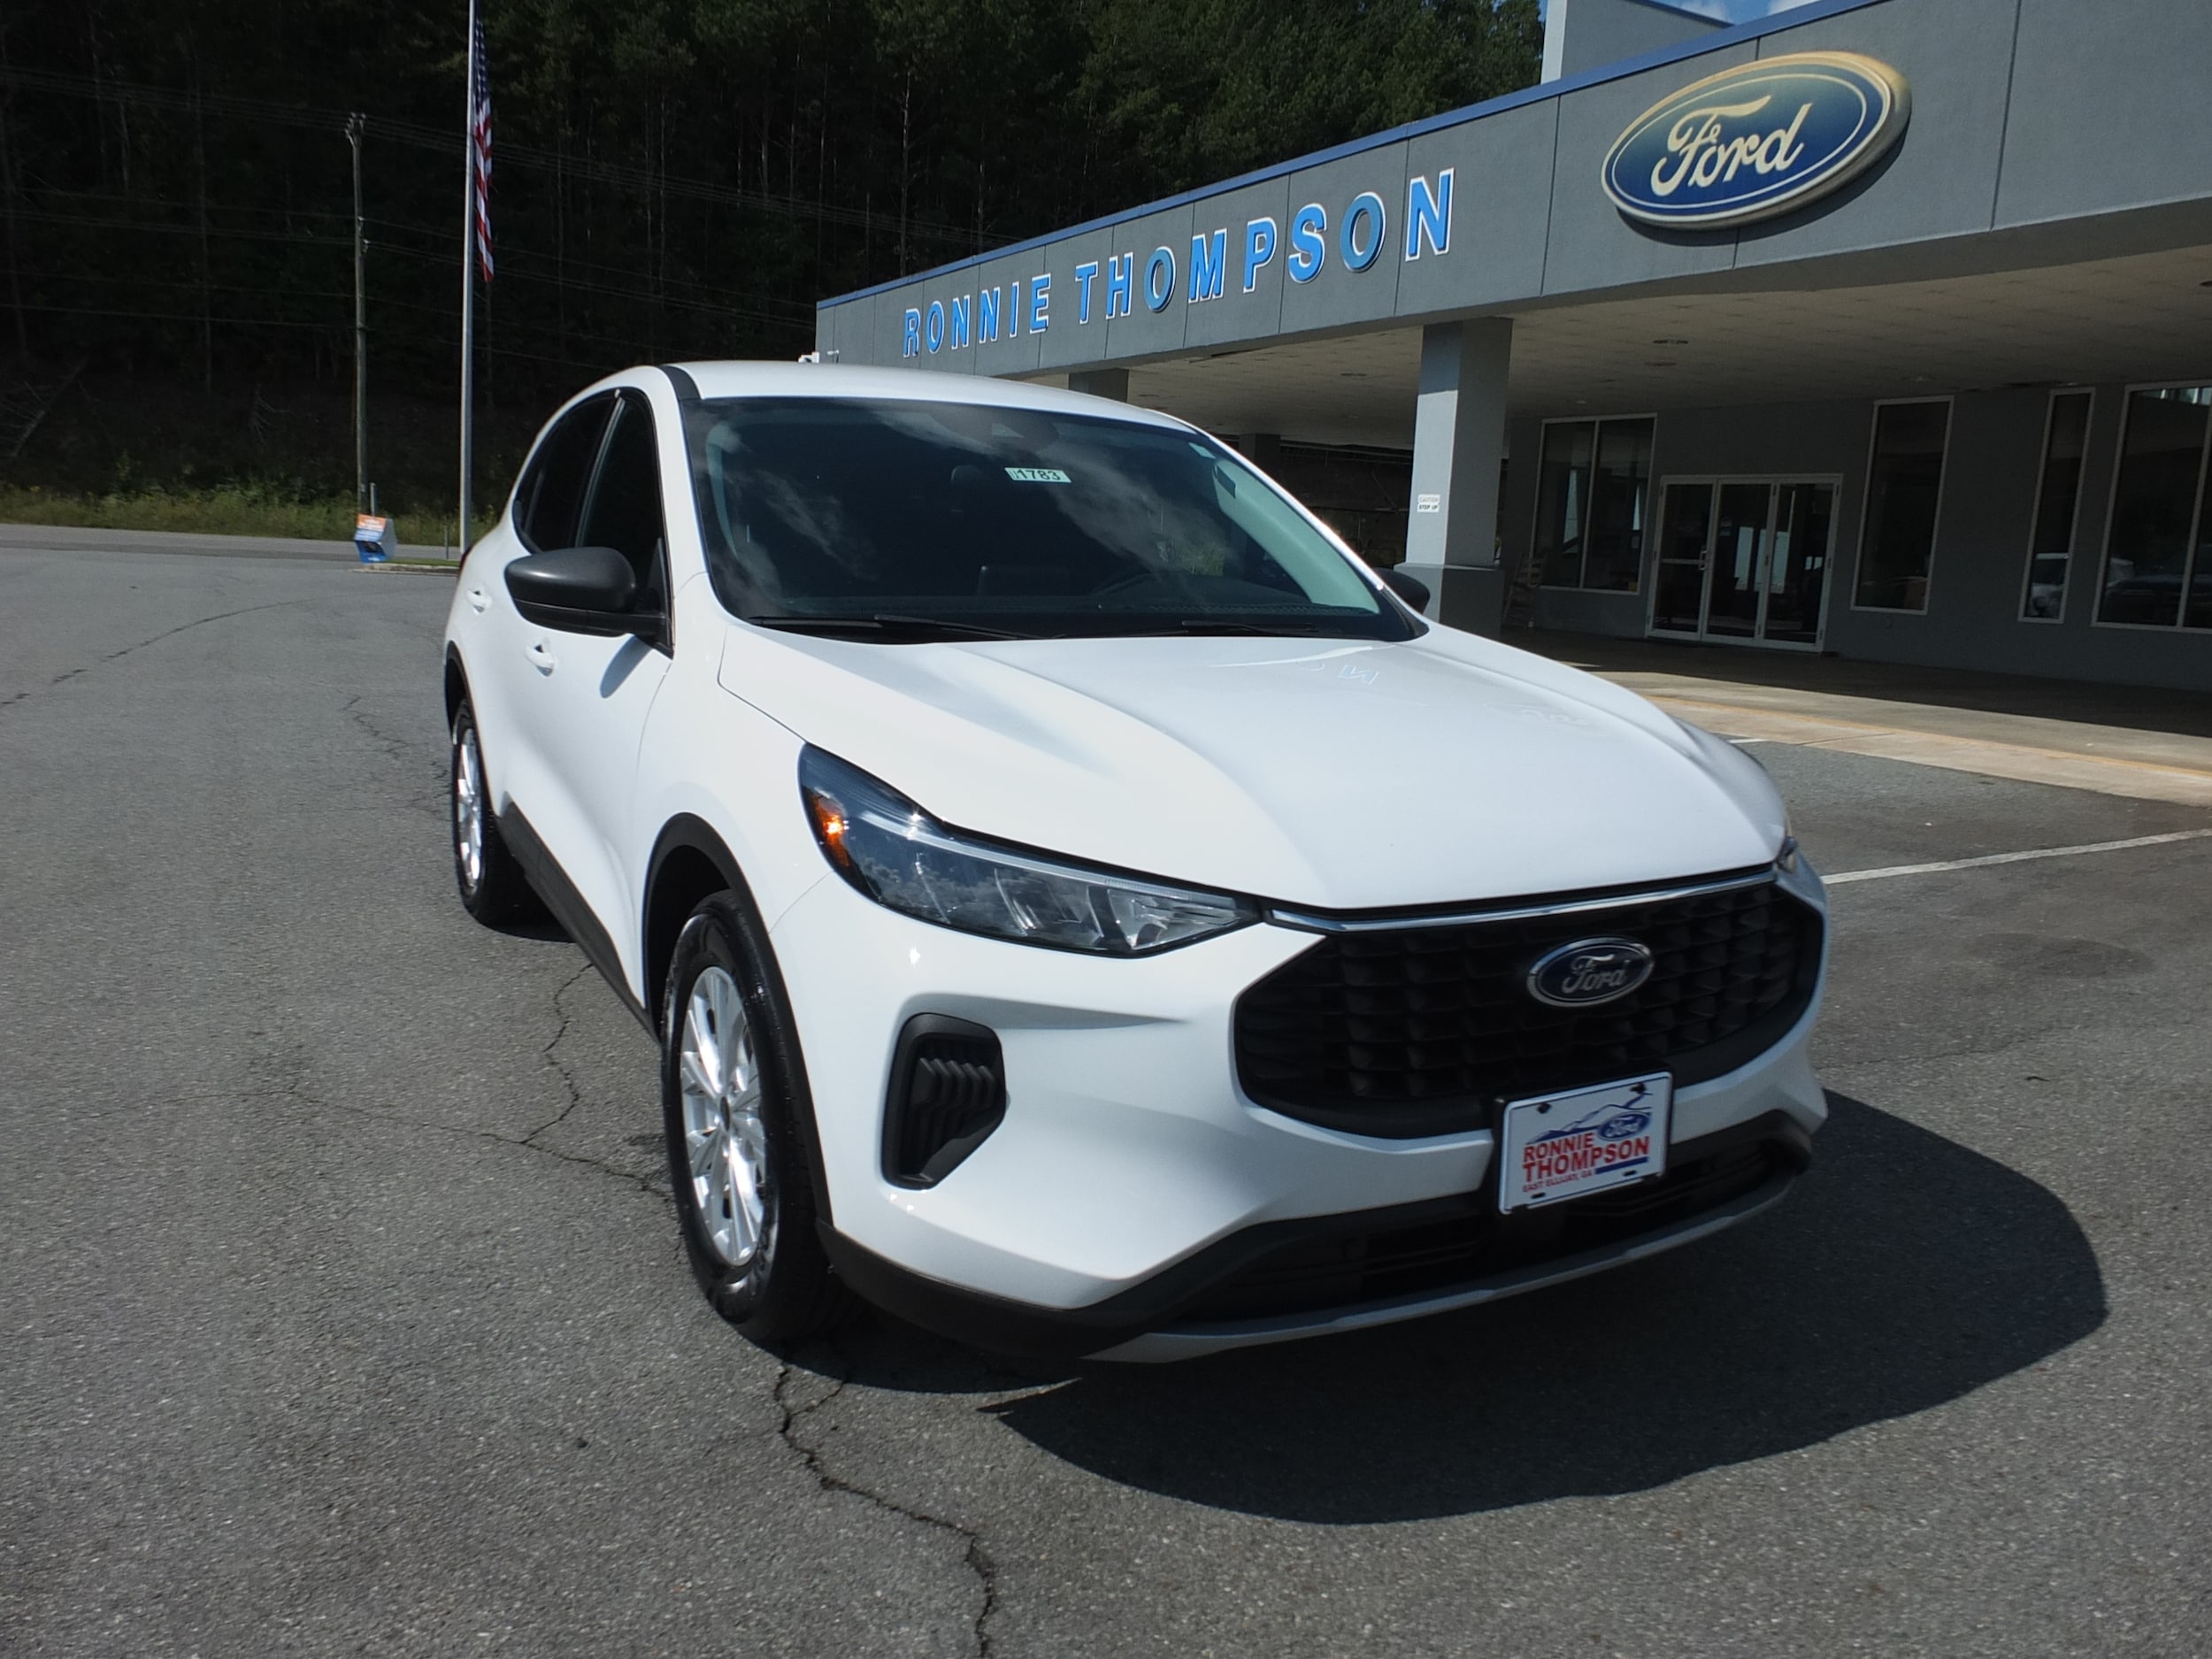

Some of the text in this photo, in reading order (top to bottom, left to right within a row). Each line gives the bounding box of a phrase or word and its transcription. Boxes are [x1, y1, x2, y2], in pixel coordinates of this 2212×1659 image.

[1651, 95, 1812, 196] Ford
[902, 168, 1455, 358] RONNIE THOMPSON
[1562, 954, 1631, 993] Ford
[1523, 1136, 1650, 1182] THOMPSON
[1524, 1132, 1594, 1164] RONNIE
